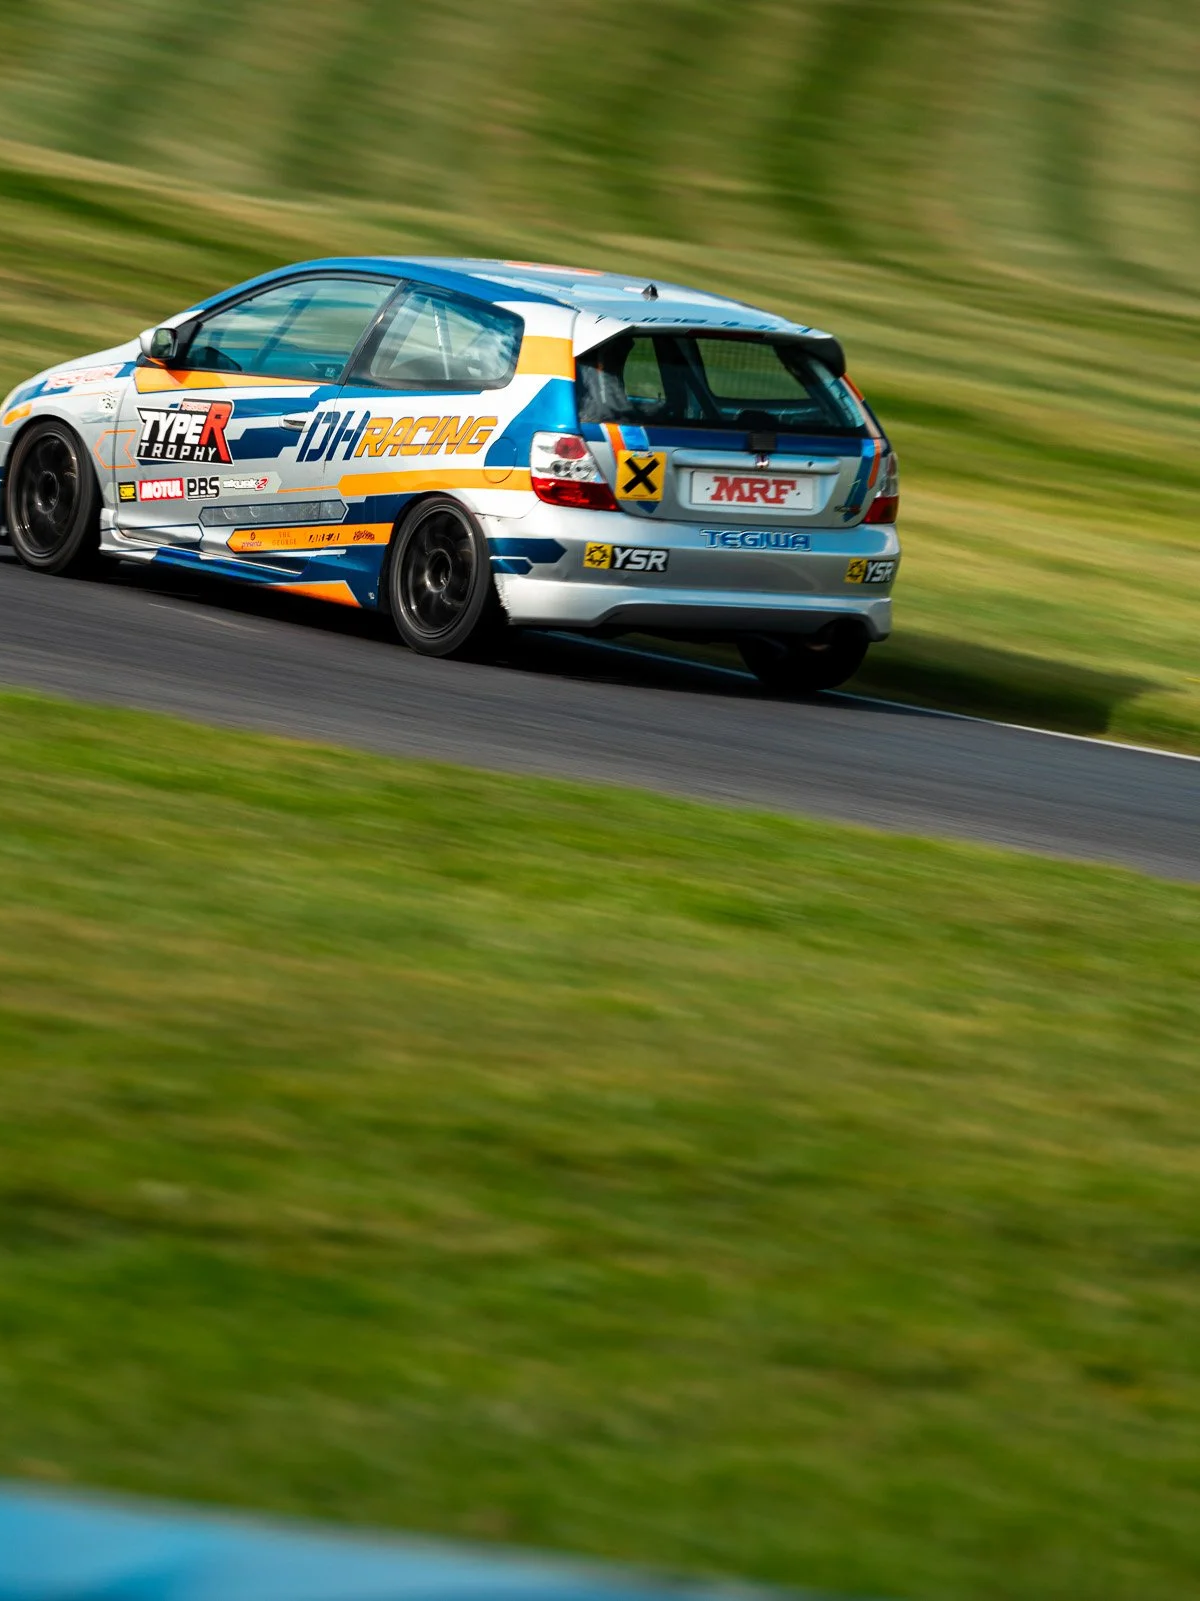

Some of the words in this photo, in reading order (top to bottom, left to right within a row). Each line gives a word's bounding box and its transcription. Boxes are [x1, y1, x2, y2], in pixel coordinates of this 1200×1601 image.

[140, 410, 207, 445] TYPE
[199, 402, 233, 462] R
[140, 443, 217, 461] TROPHY
[141, 480, 183, 499] MOTUL
[187, 476, 220, 497] PBS
[710, 476, 798, 505] MRF
[701, 529, 812, 551] TEGIWA
[613, 547, 668, 571] YSR
[865, 561, 895, 582] YSR
